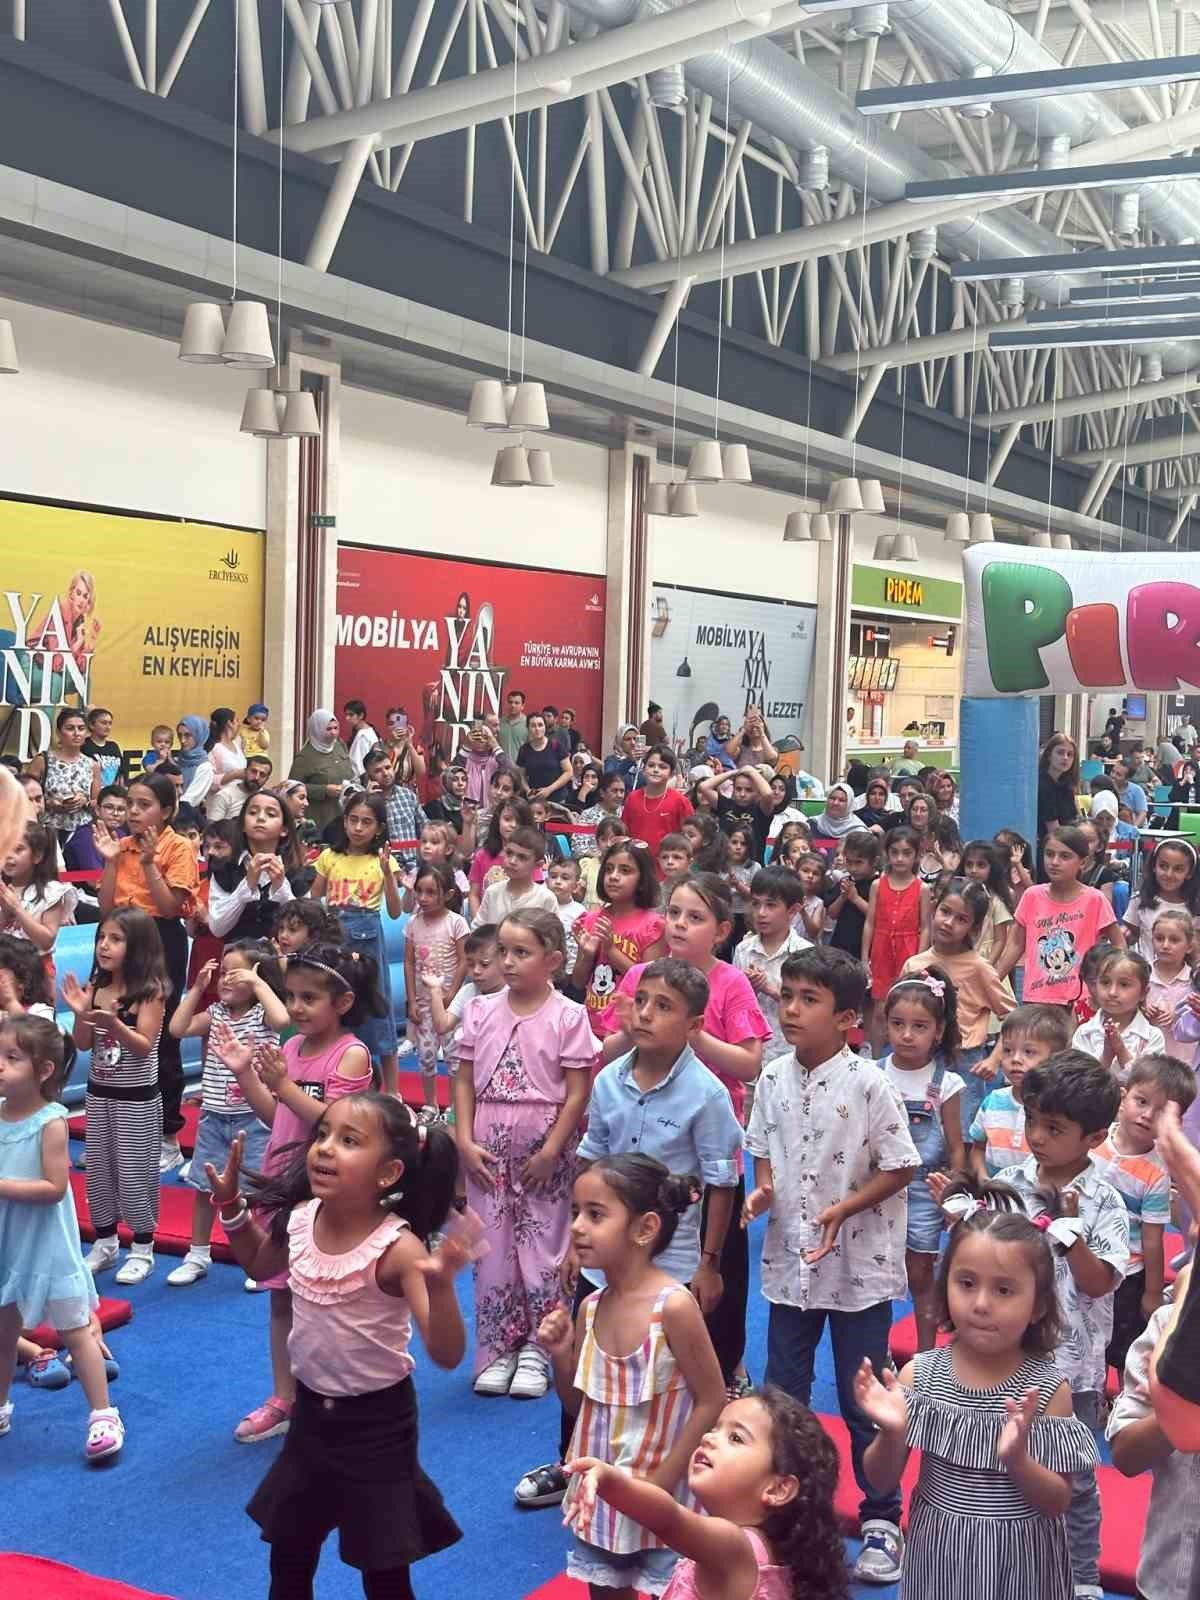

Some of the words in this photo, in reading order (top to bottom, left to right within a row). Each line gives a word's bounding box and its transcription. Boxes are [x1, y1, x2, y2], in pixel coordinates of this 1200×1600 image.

[3, 591, 70, 650] YA
[335, 609, 440, 650] MOBİLYA
[695, 624, 746, 648] MOBİLYA
[143, 624, 240, 655] ALIŞVERİŞİN
[444, 616, 490, 670] YA
[748, 630, 765, 660] YA
[143, 656, 165, 676] EN
[169, 652, 240, 679] KEYİFLİSİ
[520, 655, 530, 667] EN
[741, 659, 772, 691] NIN
[0, 649, 95, 707] NIN
[434, 669, 506, 722] NIN
[766, 701, 804, 719] LEZZET
